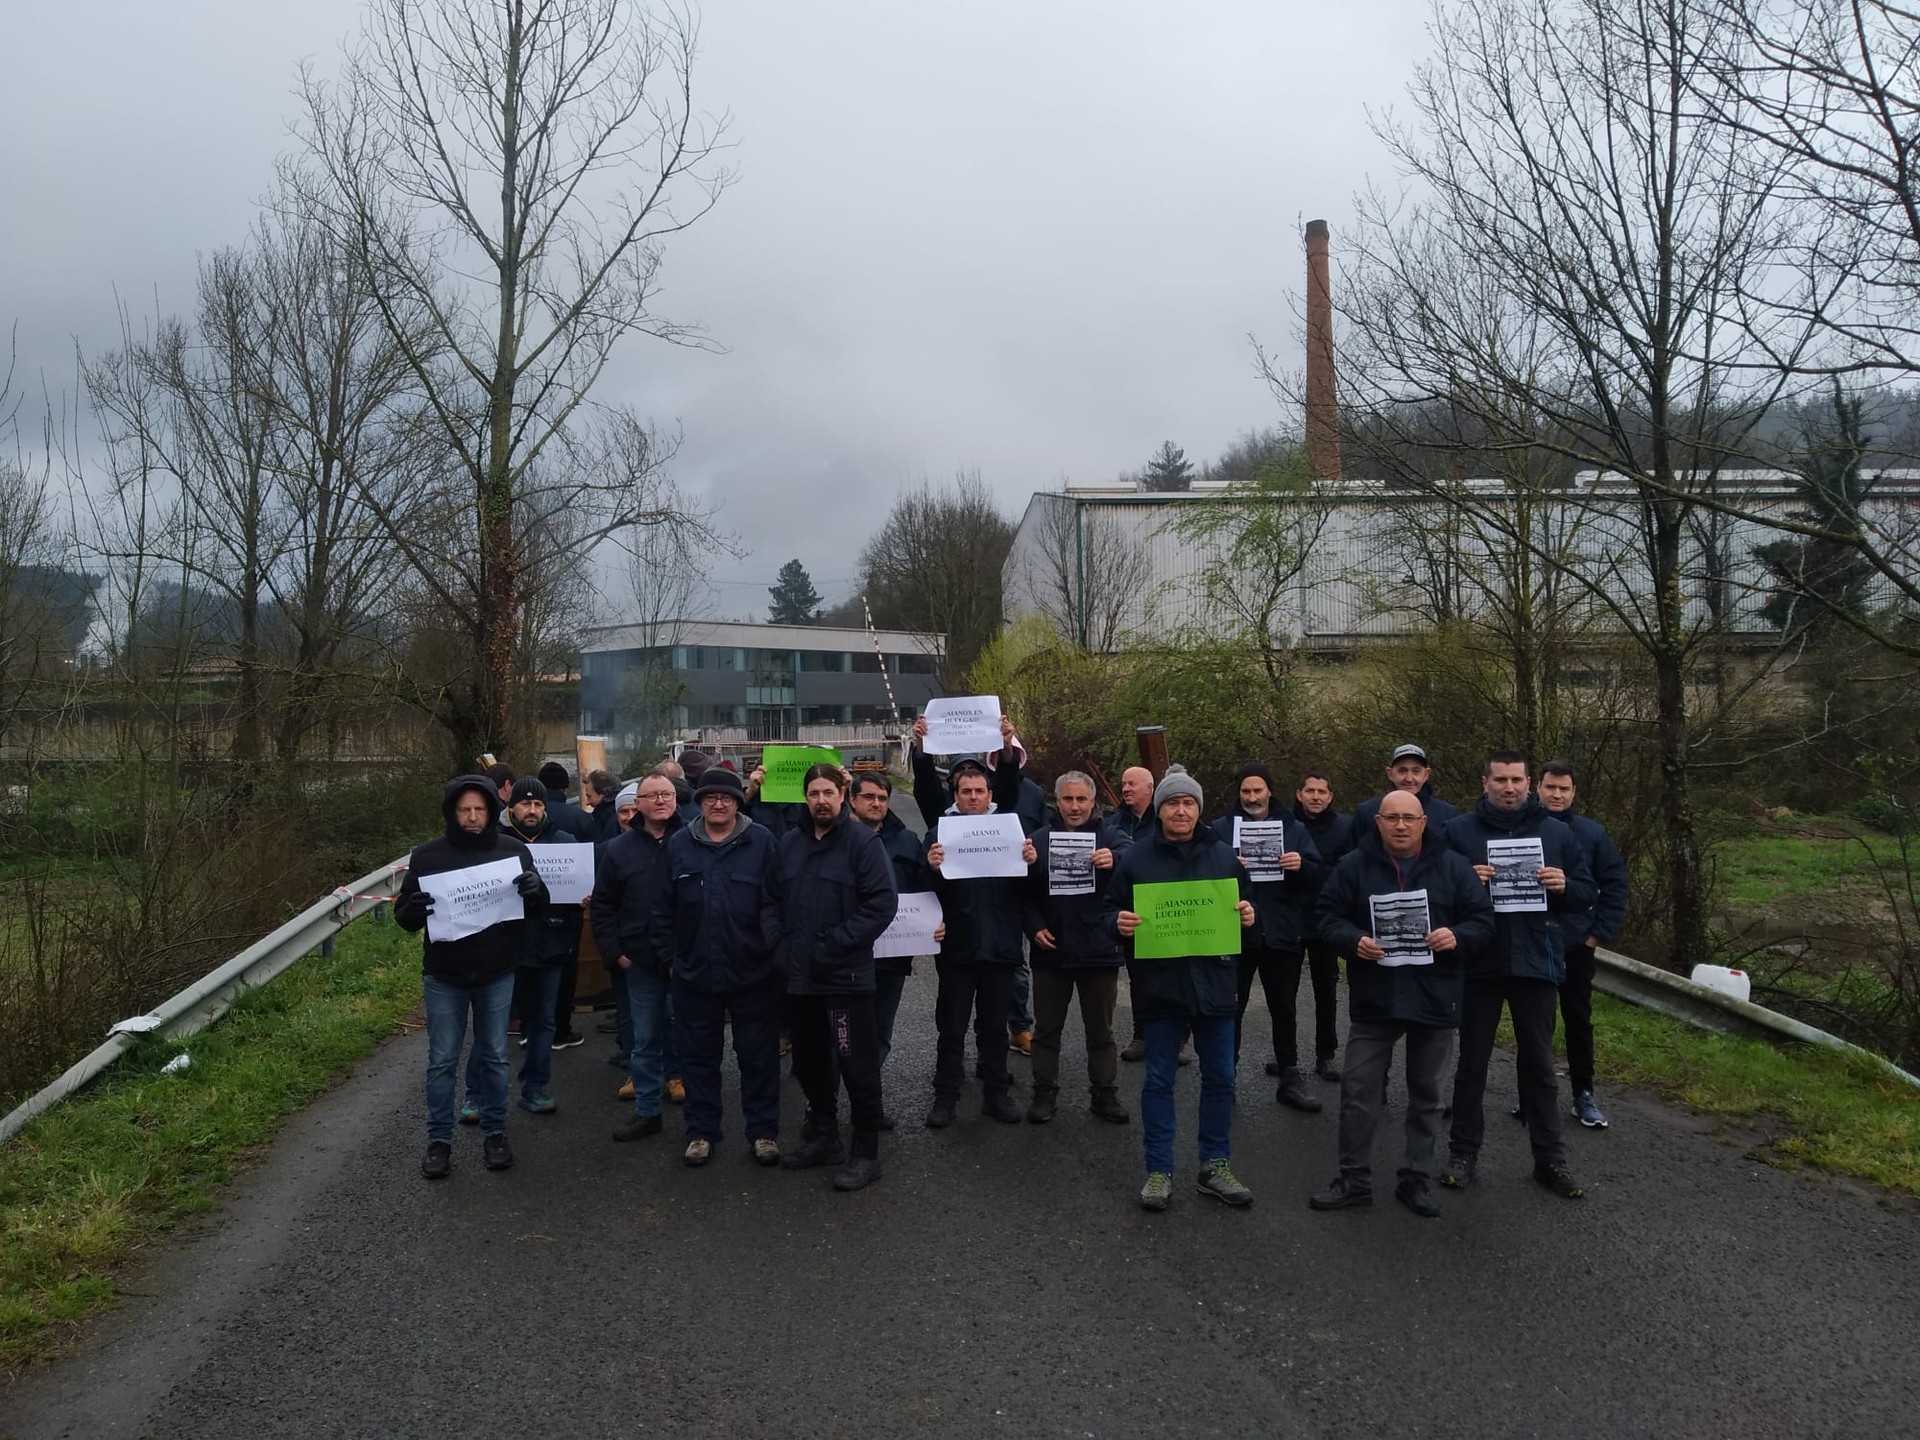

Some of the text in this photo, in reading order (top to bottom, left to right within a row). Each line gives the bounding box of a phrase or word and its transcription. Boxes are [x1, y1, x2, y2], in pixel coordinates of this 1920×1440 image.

[957, 845, 1010, 854] BORROKAN!!!
[490, 878, 503, 887] EN
[454, 888, 498, 904] HUELGA!!!
[464, 901, 478, 909] POR
[1201, 898, 1214, 906] EN
[449, 906, 484, 920] CONVENIO
[1155, 909, 1195, 919] LUCHA!!!
[1155, 928, 1217, 938] CONVENIO JUSTO
